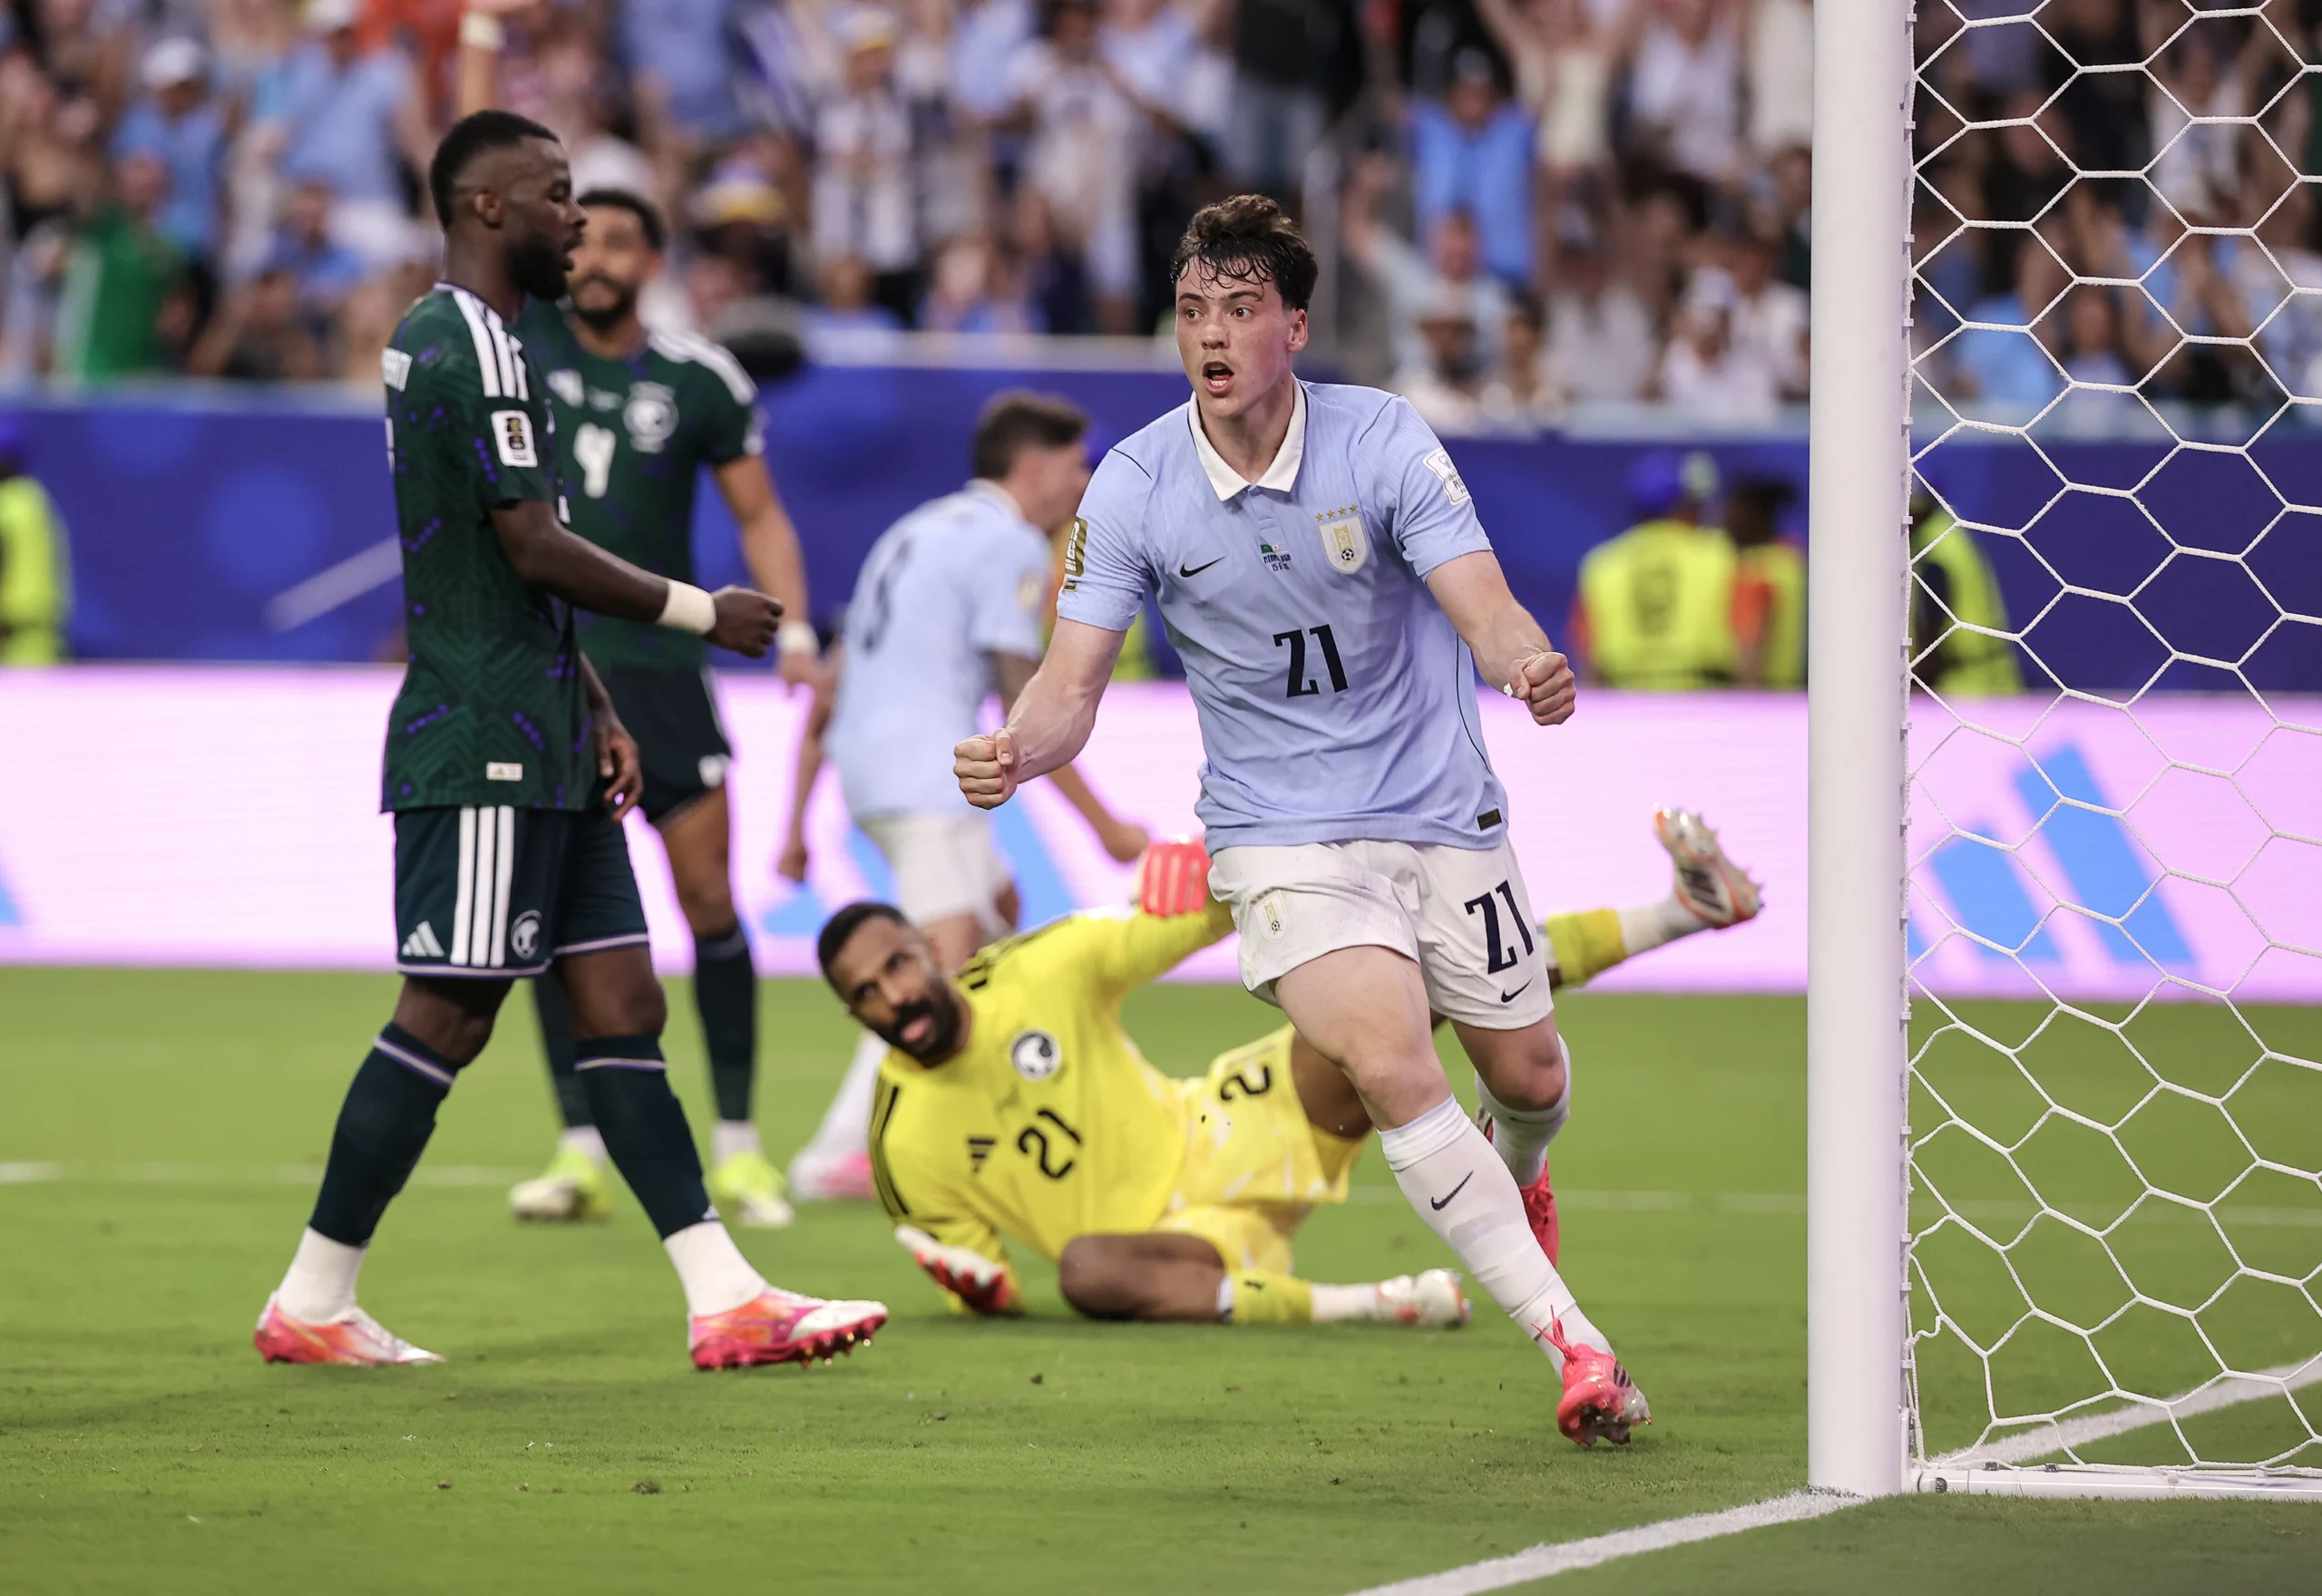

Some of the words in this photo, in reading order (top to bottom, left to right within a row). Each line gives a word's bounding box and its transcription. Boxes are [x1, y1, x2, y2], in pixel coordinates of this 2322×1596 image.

[1273, 624, 1349, 698] 21
[1464, 880, 1535, 975] 21
[1017, 1109, 1082, 1180] 21
